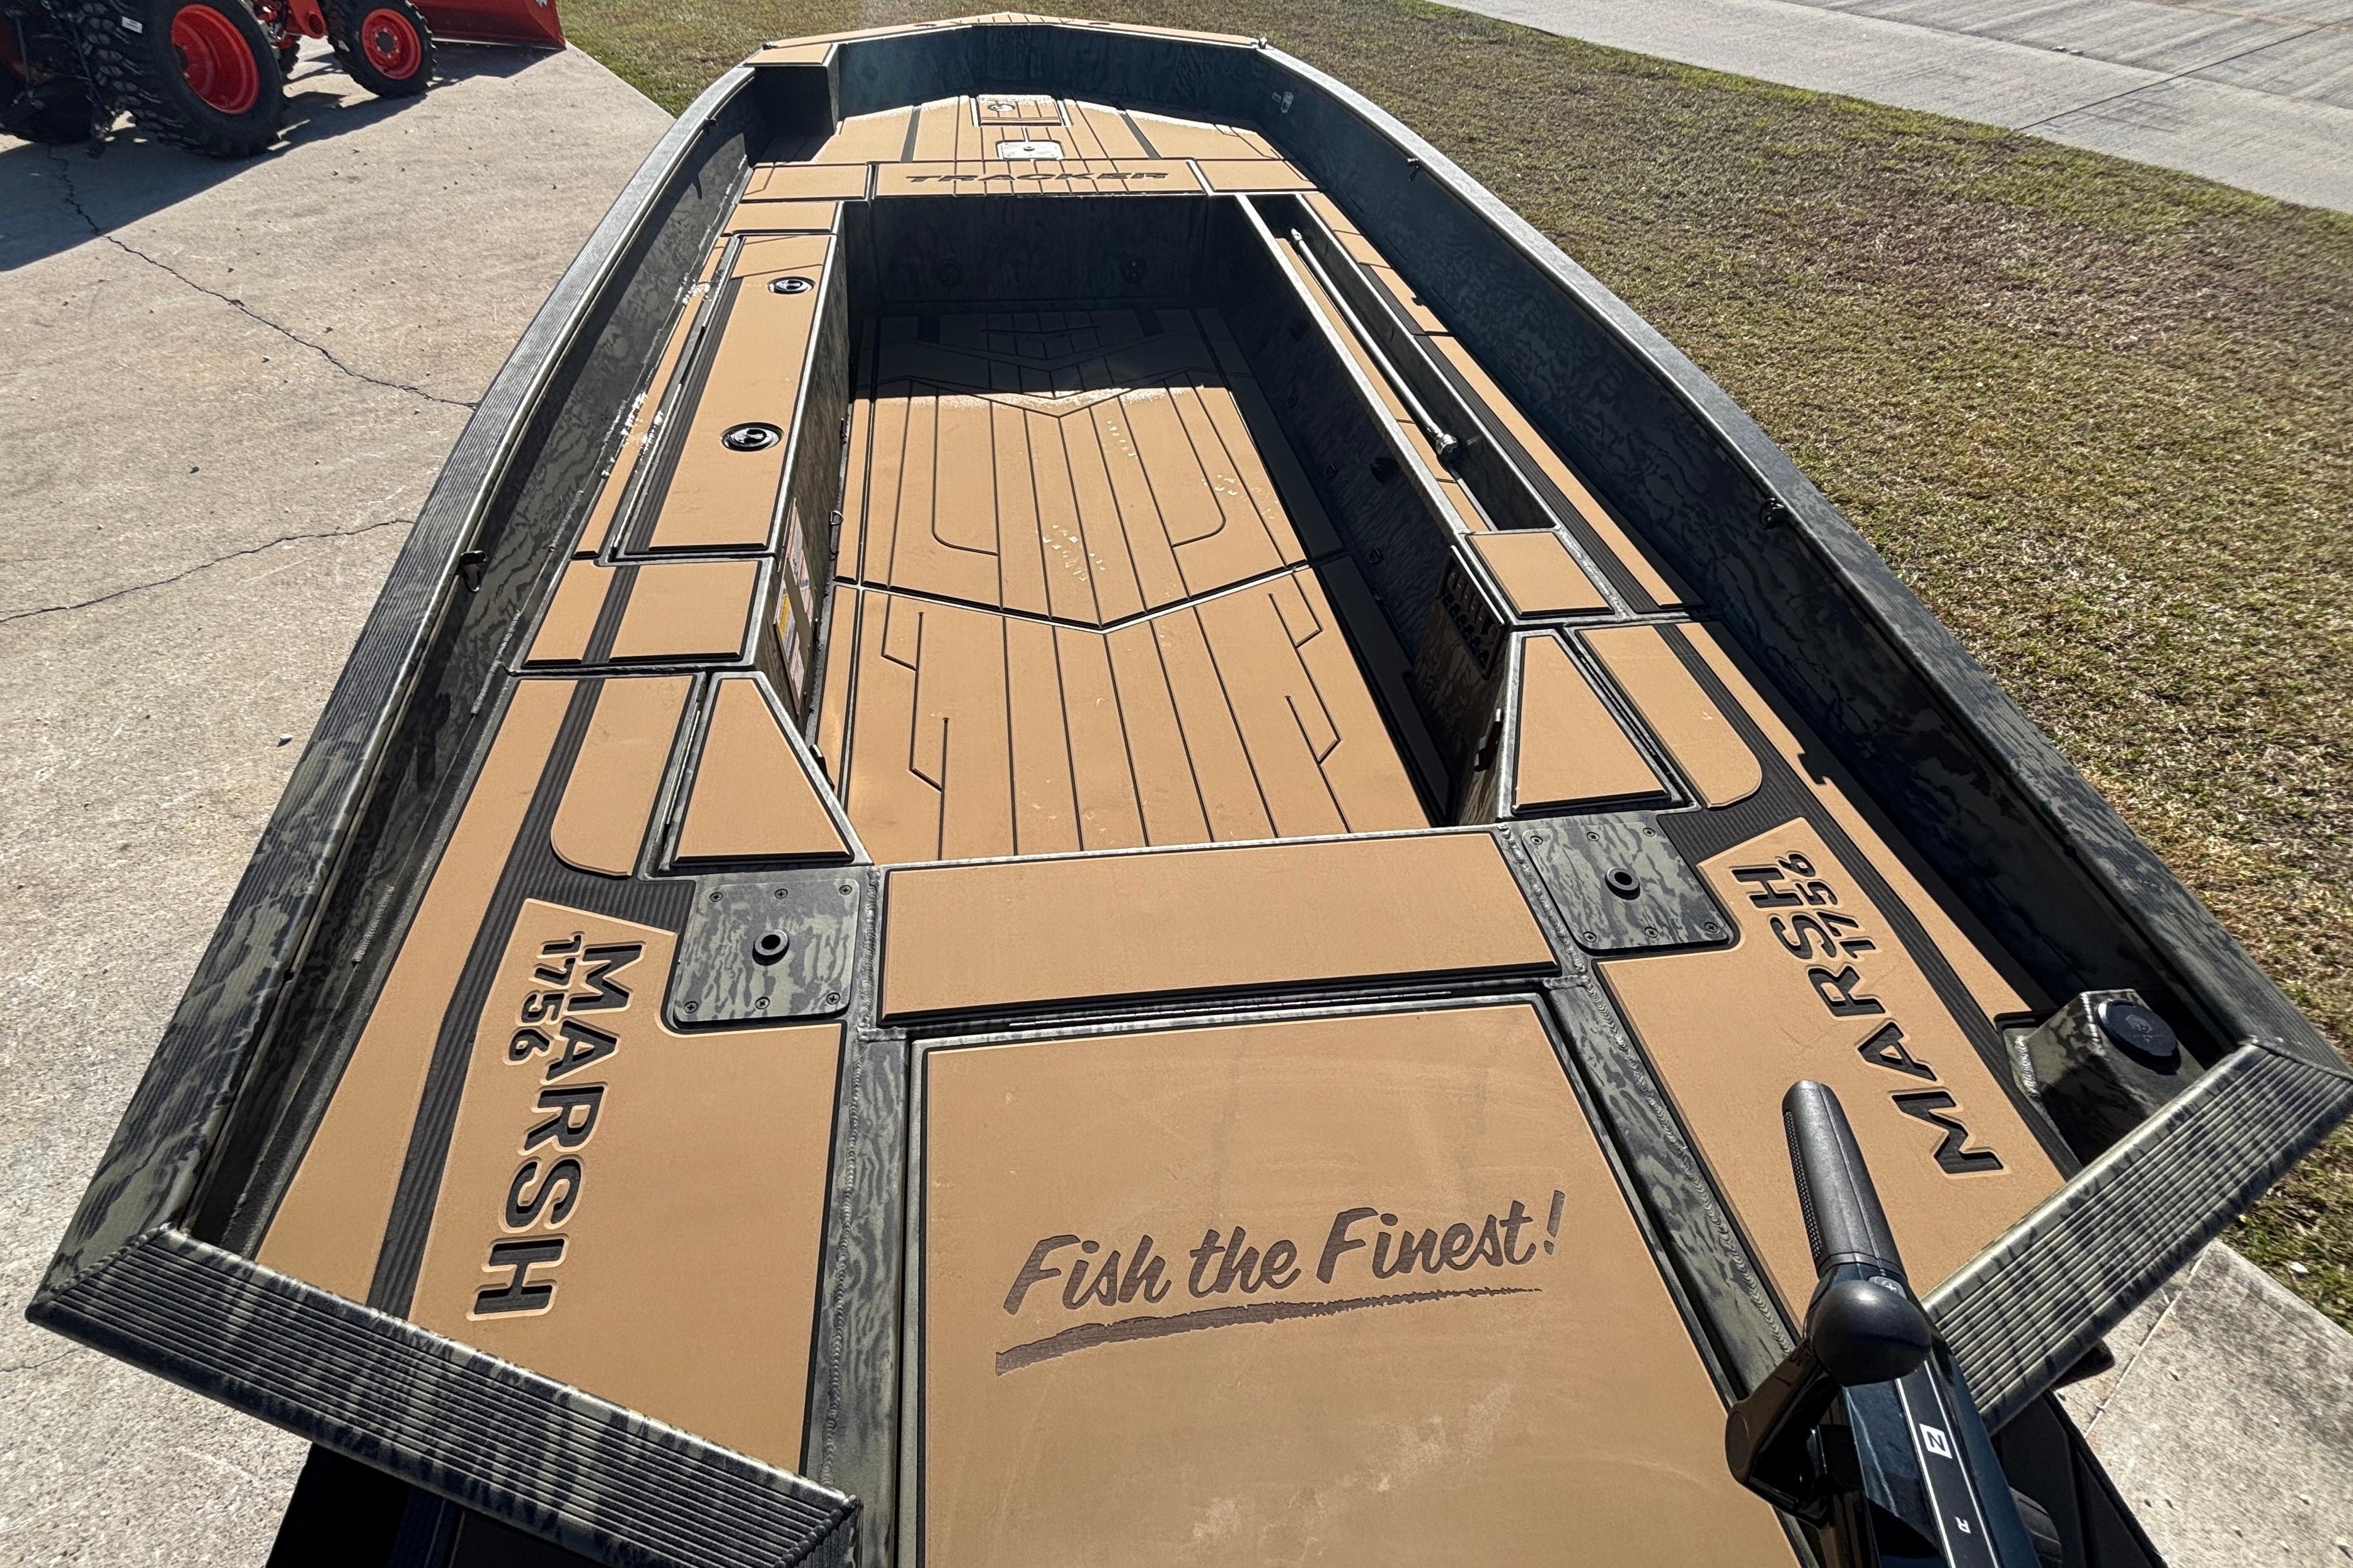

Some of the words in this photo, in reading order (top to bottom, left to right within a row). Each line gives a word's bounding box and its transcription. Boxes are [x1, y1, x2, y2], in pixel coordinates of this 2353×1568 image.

[906, 172, 1170, 183] TRACKER
[1779, 851, 1877, 959] 1756
[507, 931, 584, 1063] 1756
[1731, 865, 2005, 1176] MARSH
[472, 939, 645, 1315] MARSH
[1003, 1233, 1172, 1315] Fish
[1187, 1225, 1301, 1298] the
[1316, 1189, 1565, 1285] Finest!
[1955, 1517, 1971, 1534] R
